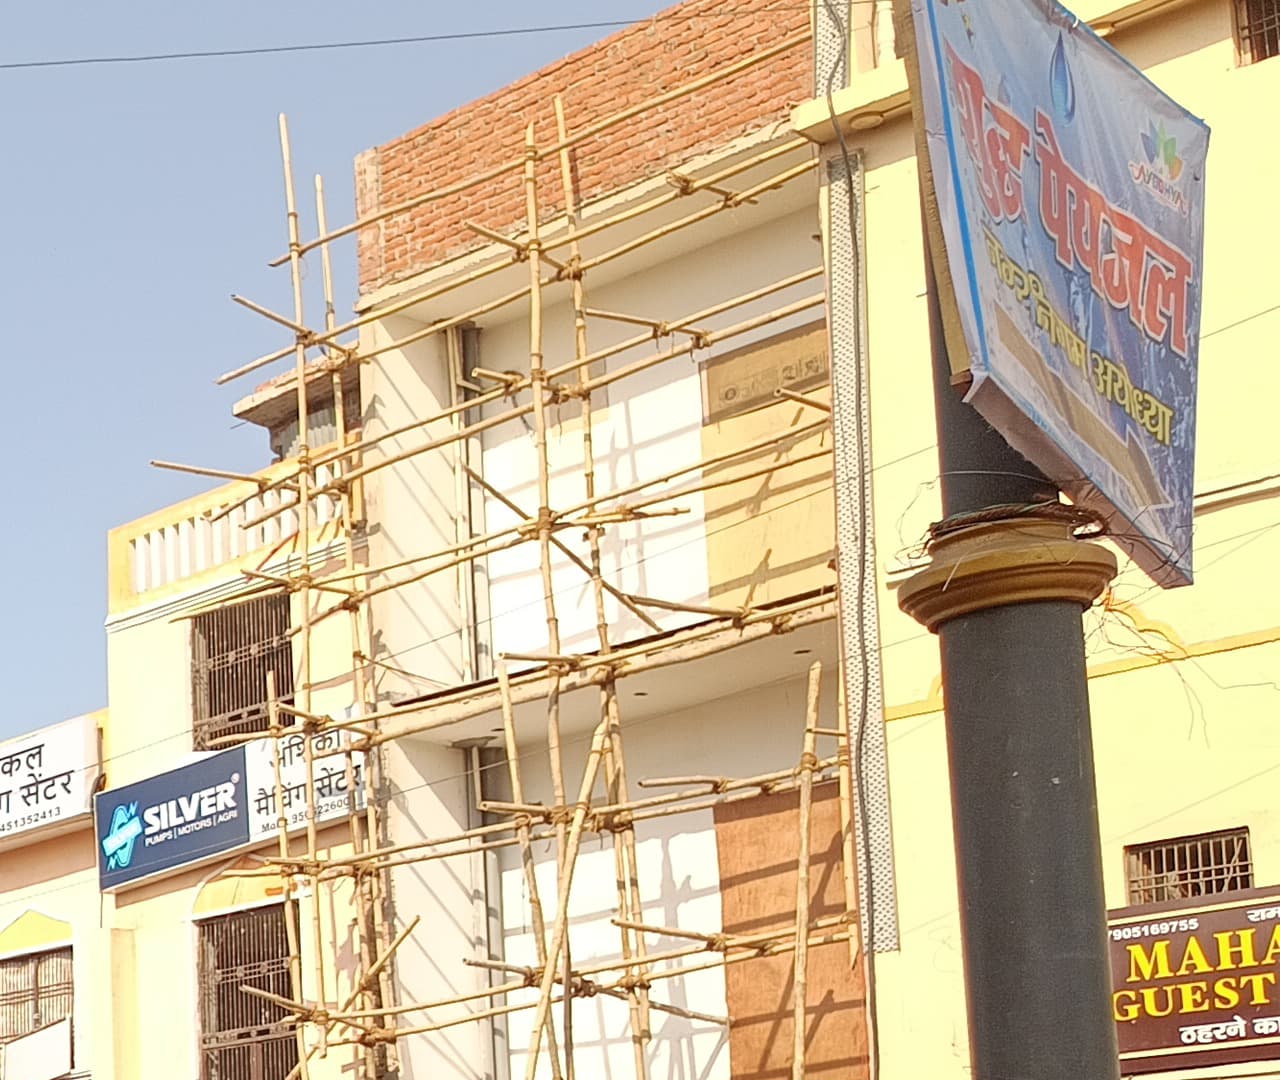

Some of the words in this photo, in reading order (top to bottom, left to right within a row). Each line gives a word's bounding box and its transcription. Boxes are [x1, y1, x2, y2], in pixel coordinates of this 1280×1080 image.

[1035, 108, 1193, 362] पेयजल
[1091, 352, 1175, 446] अयोध्या
[19, 769, 75, 807] सेंटर
[143, 782, 237, 836] SILVER
[144, 830, 173, 847] PUMPS
[178, 818, 212, 835] MOTORS
[1113, 972, 1276, 1022] GUEST
[1179, 1015, 1247, 1044] ठहरने
